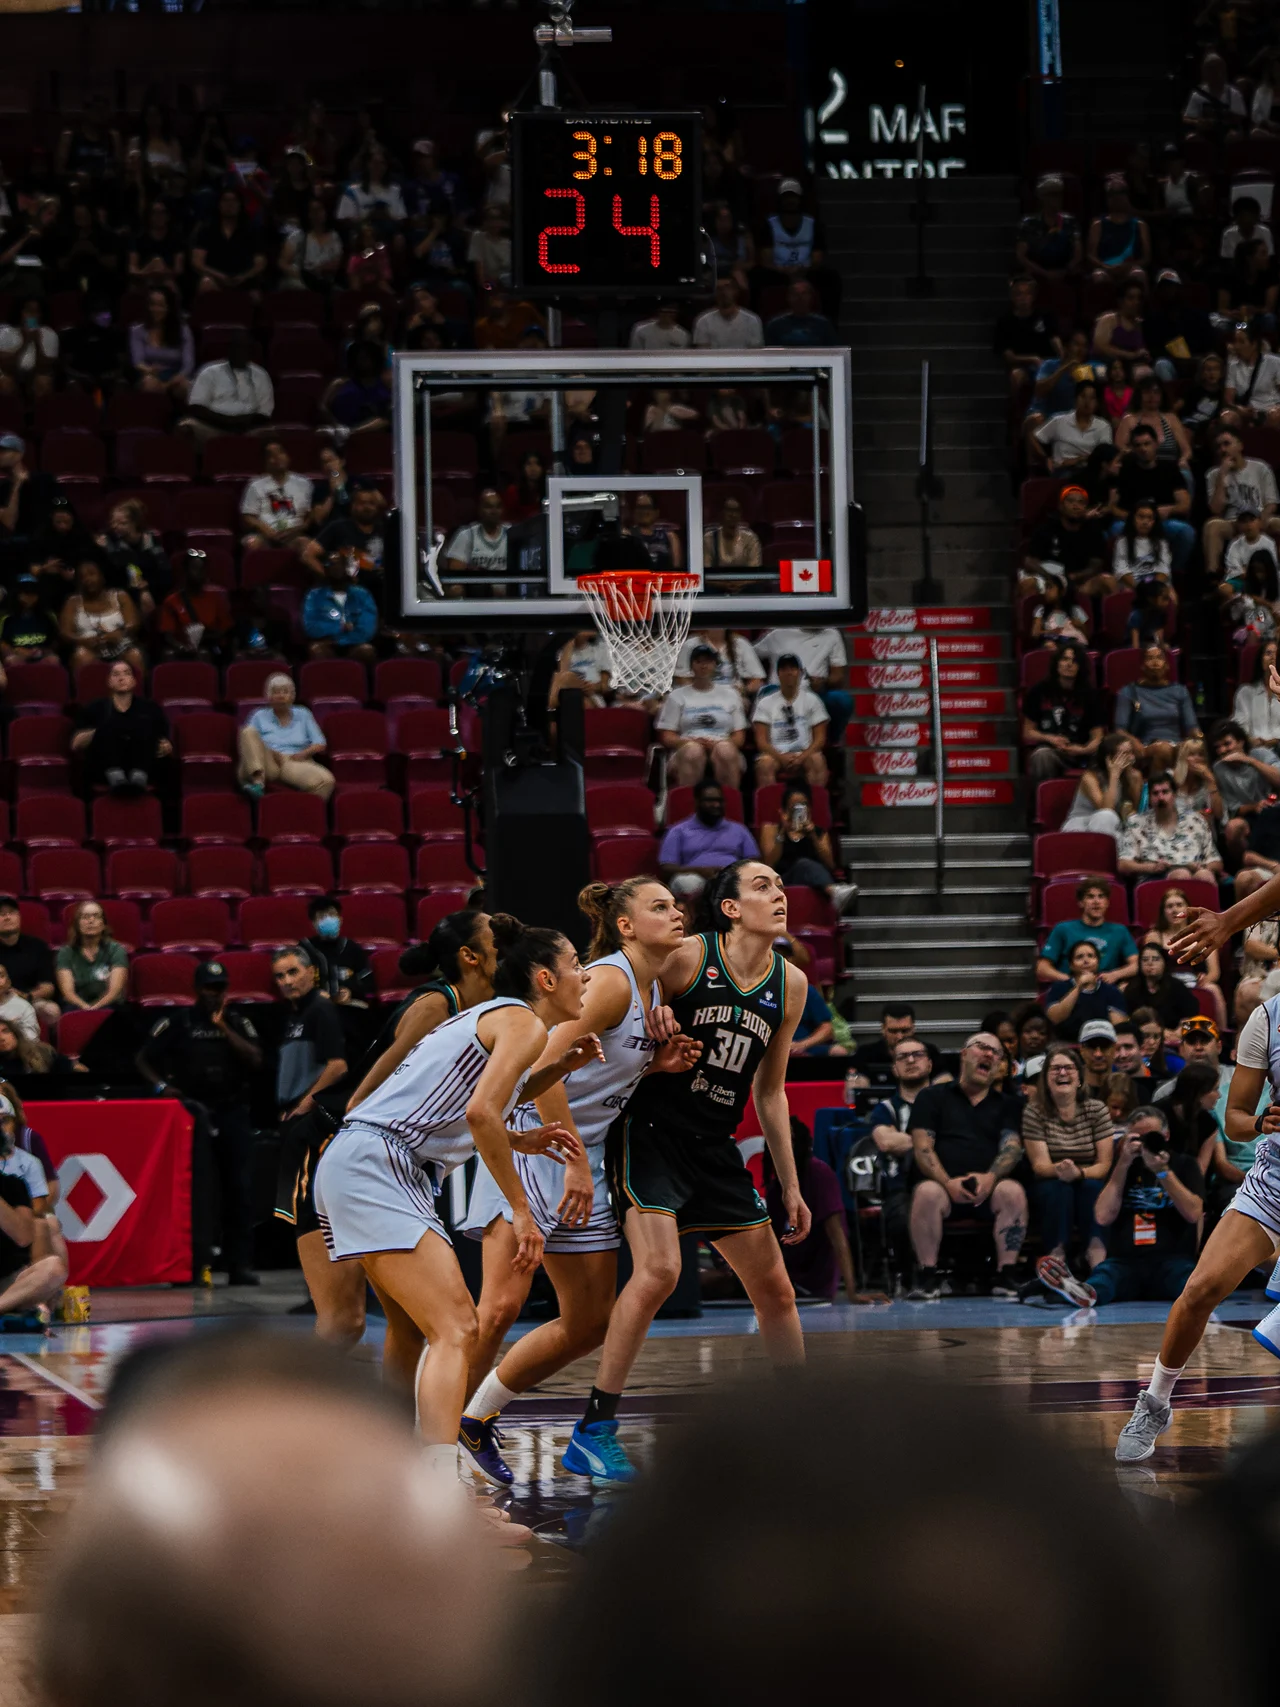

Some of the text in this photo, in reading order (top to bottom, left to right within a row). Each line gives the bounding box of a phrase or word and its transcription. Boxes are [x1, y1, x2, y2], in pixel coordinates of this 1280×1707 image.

[572, 130, 683, 180] 3:18
[537, 187, 660, 274] 24
[862, 608, 918, 632] Molson
[870, 635, 927, 661] Molson
[866, 664, 924, 689] Molson
[873, 692, 930, 717] Molson
[864, 721, 921, 746] Molson
[870, 750, 917, 775] Mols
[878, 780, 937, 806] Molson
[692, 1005, 773, 1048] NEW YORK
[706, 1028, 753, 1074] 30
[706, 1091, 736, 1107] Mutual
[712, 1084, 737, 1096] Liberty
